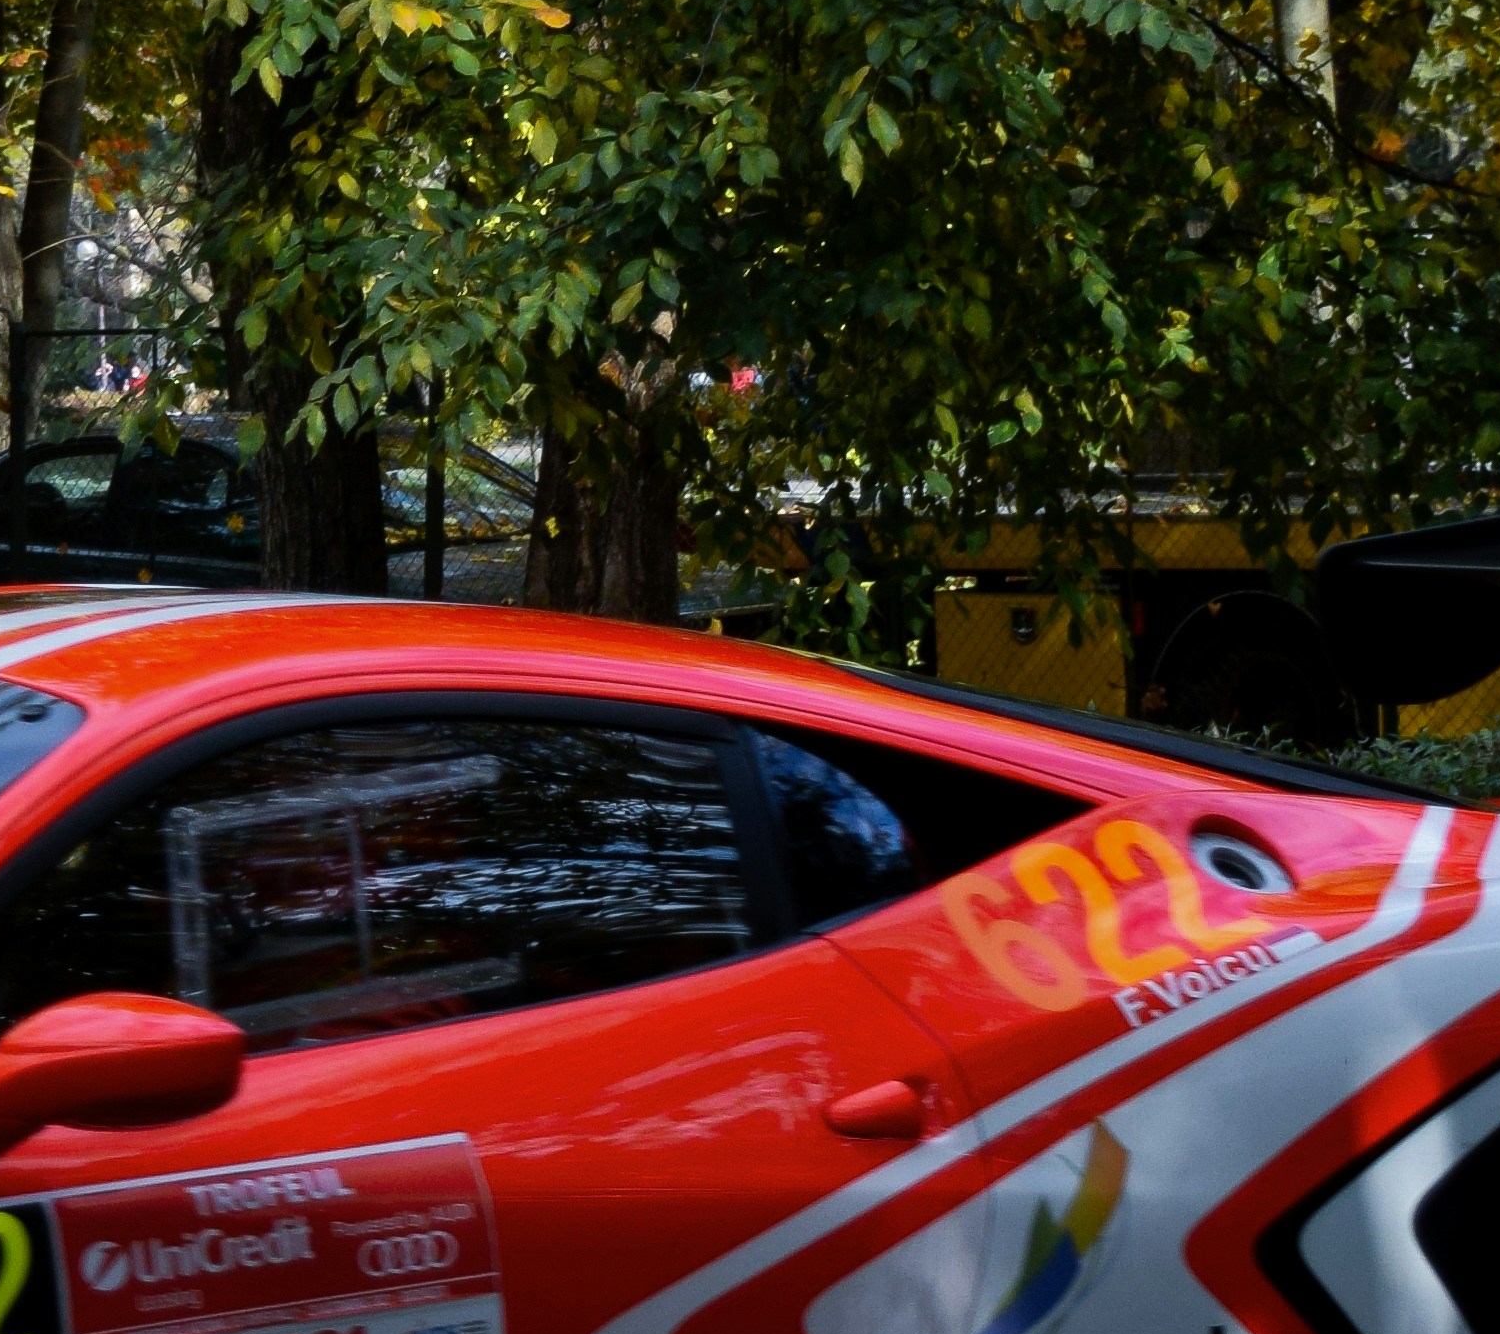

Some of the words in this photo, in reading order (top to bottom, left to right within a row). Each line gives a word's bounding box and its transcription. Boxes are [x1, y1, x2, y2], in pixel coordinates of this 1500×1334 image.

[941, 819, 1275, 1012] 622
[184, 1167, 356, 1217] TROFEUL
[130, 1216, 318, 1285] UniCredit
